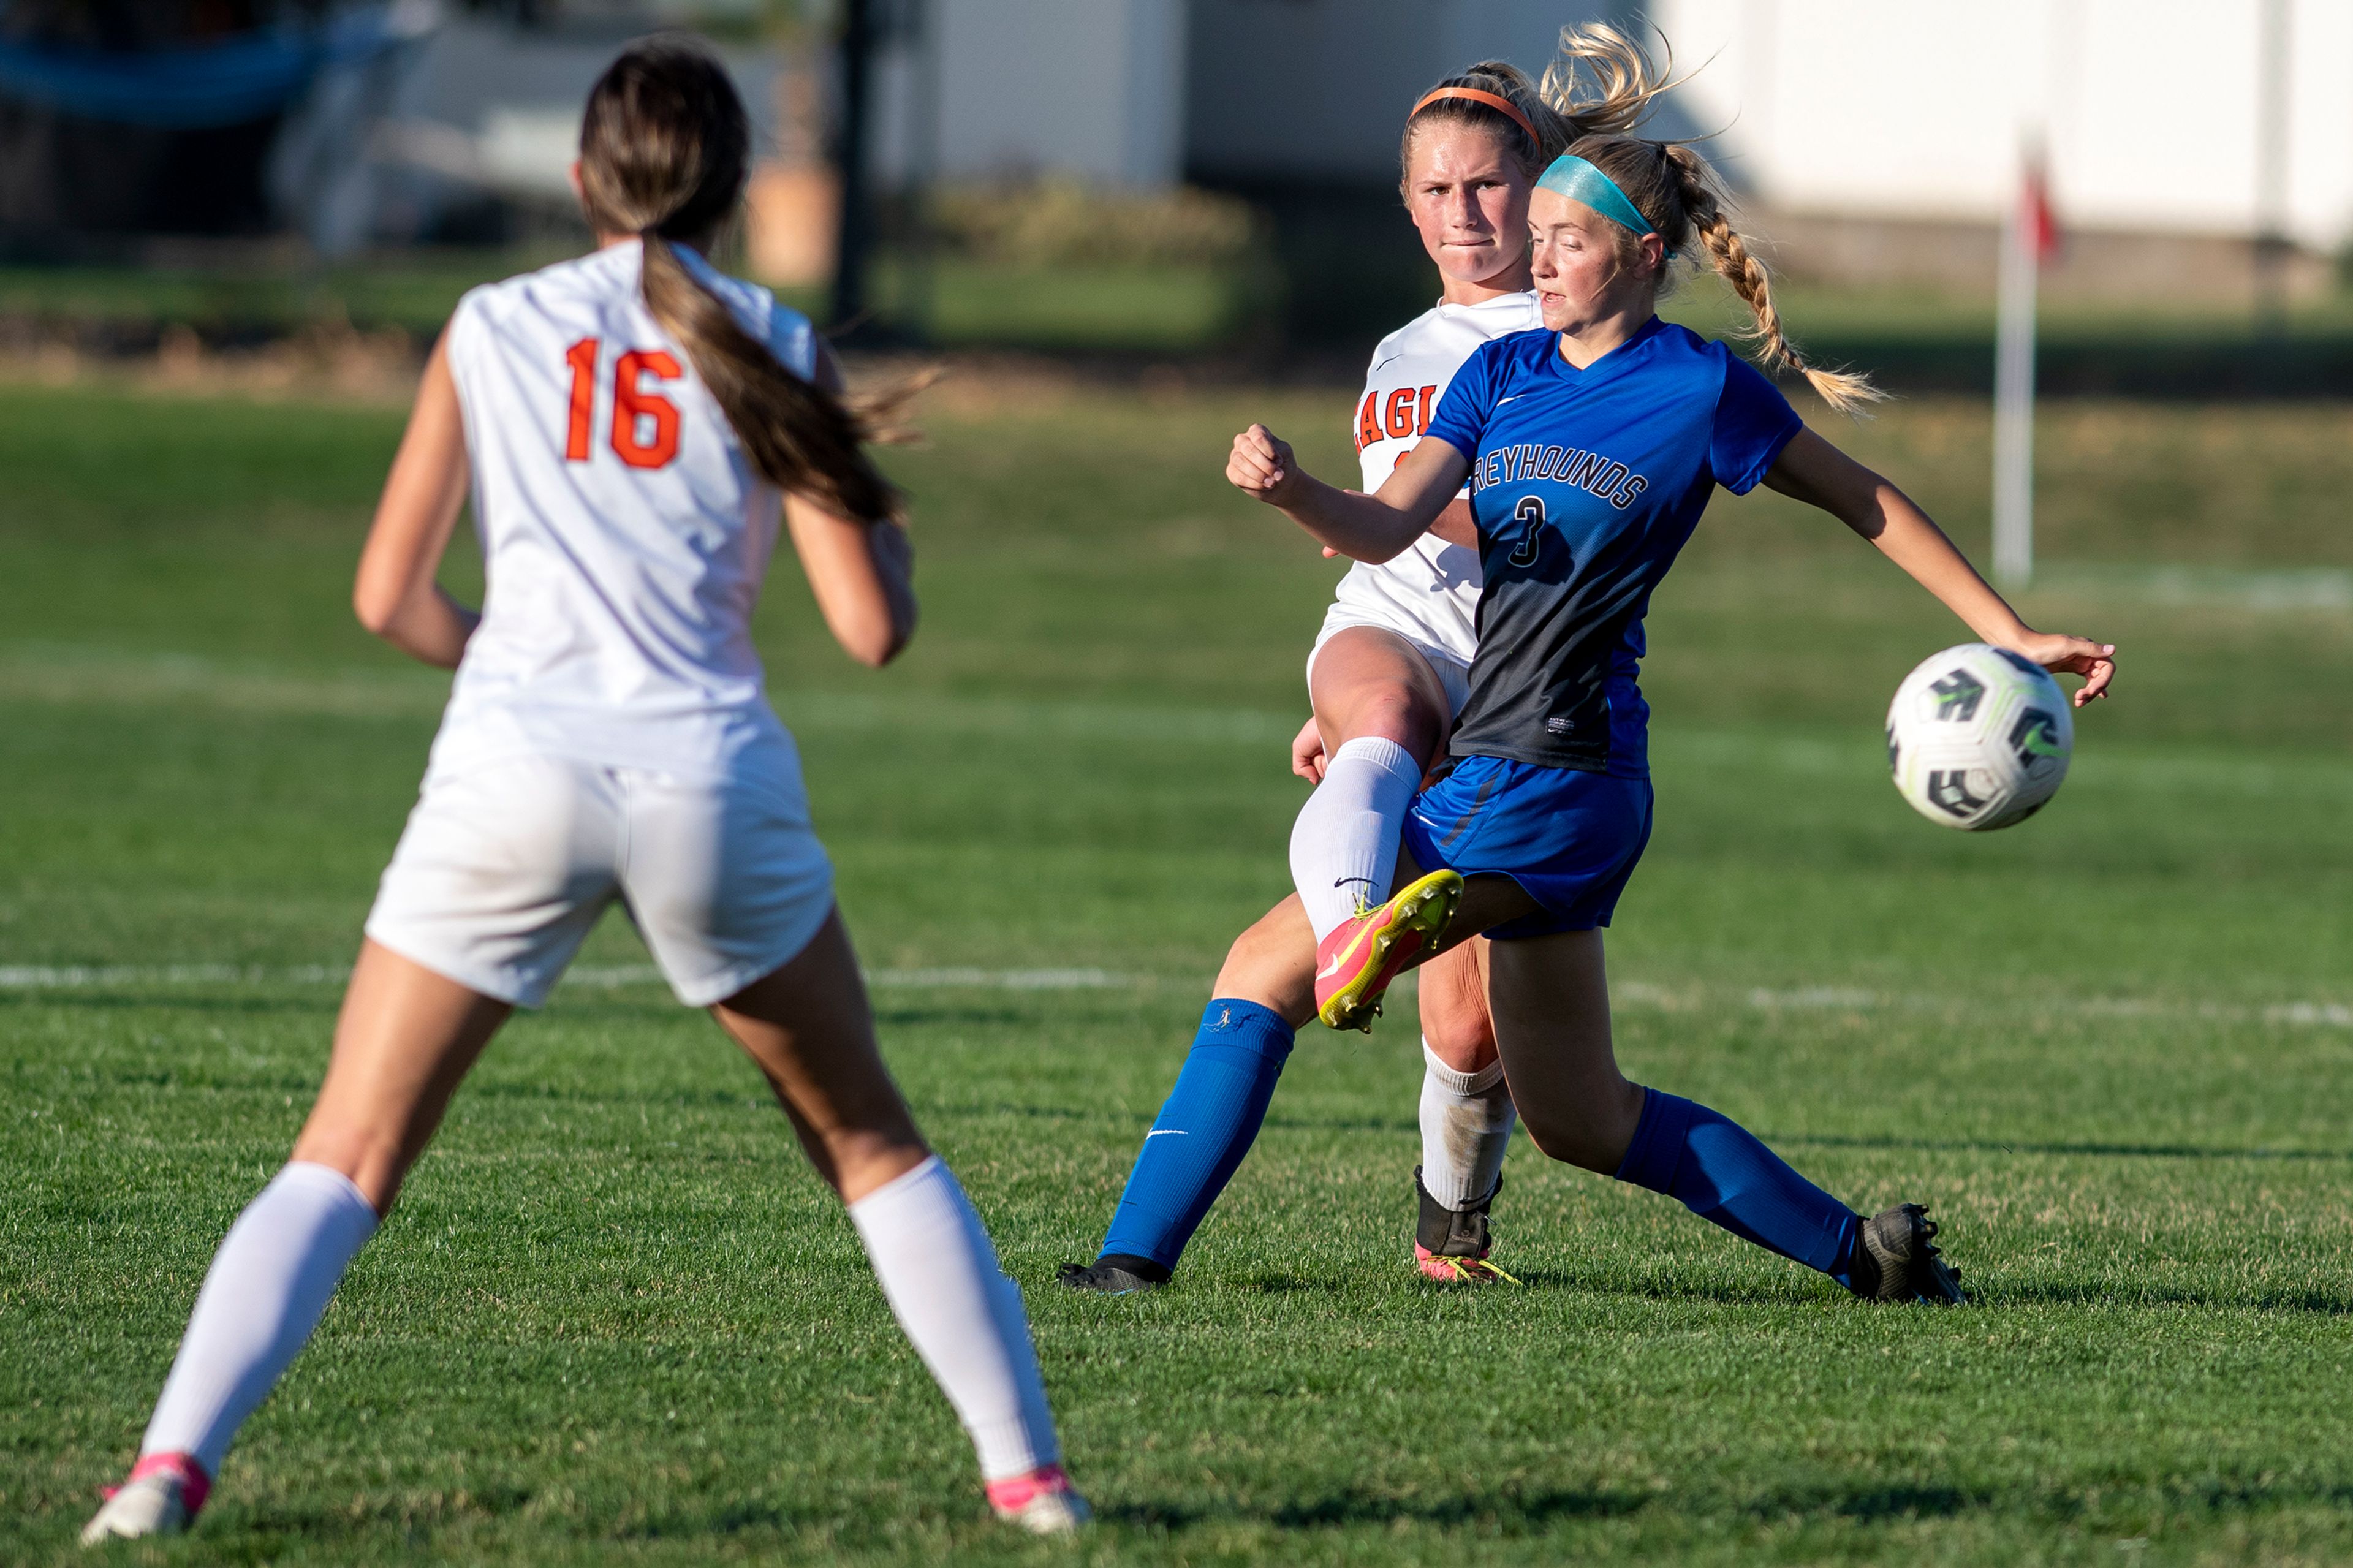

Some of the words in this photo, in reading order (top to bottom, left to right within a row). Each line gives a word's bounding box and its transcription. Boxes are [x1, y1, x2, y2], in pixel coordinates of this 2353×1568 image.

[564, 337, 683, 470] 16
[1354, 385, 1438, 456] AGL
[1472, 444, 1649, 510] REYHOUNDS
[1508, 494, 1546, 568] 3
